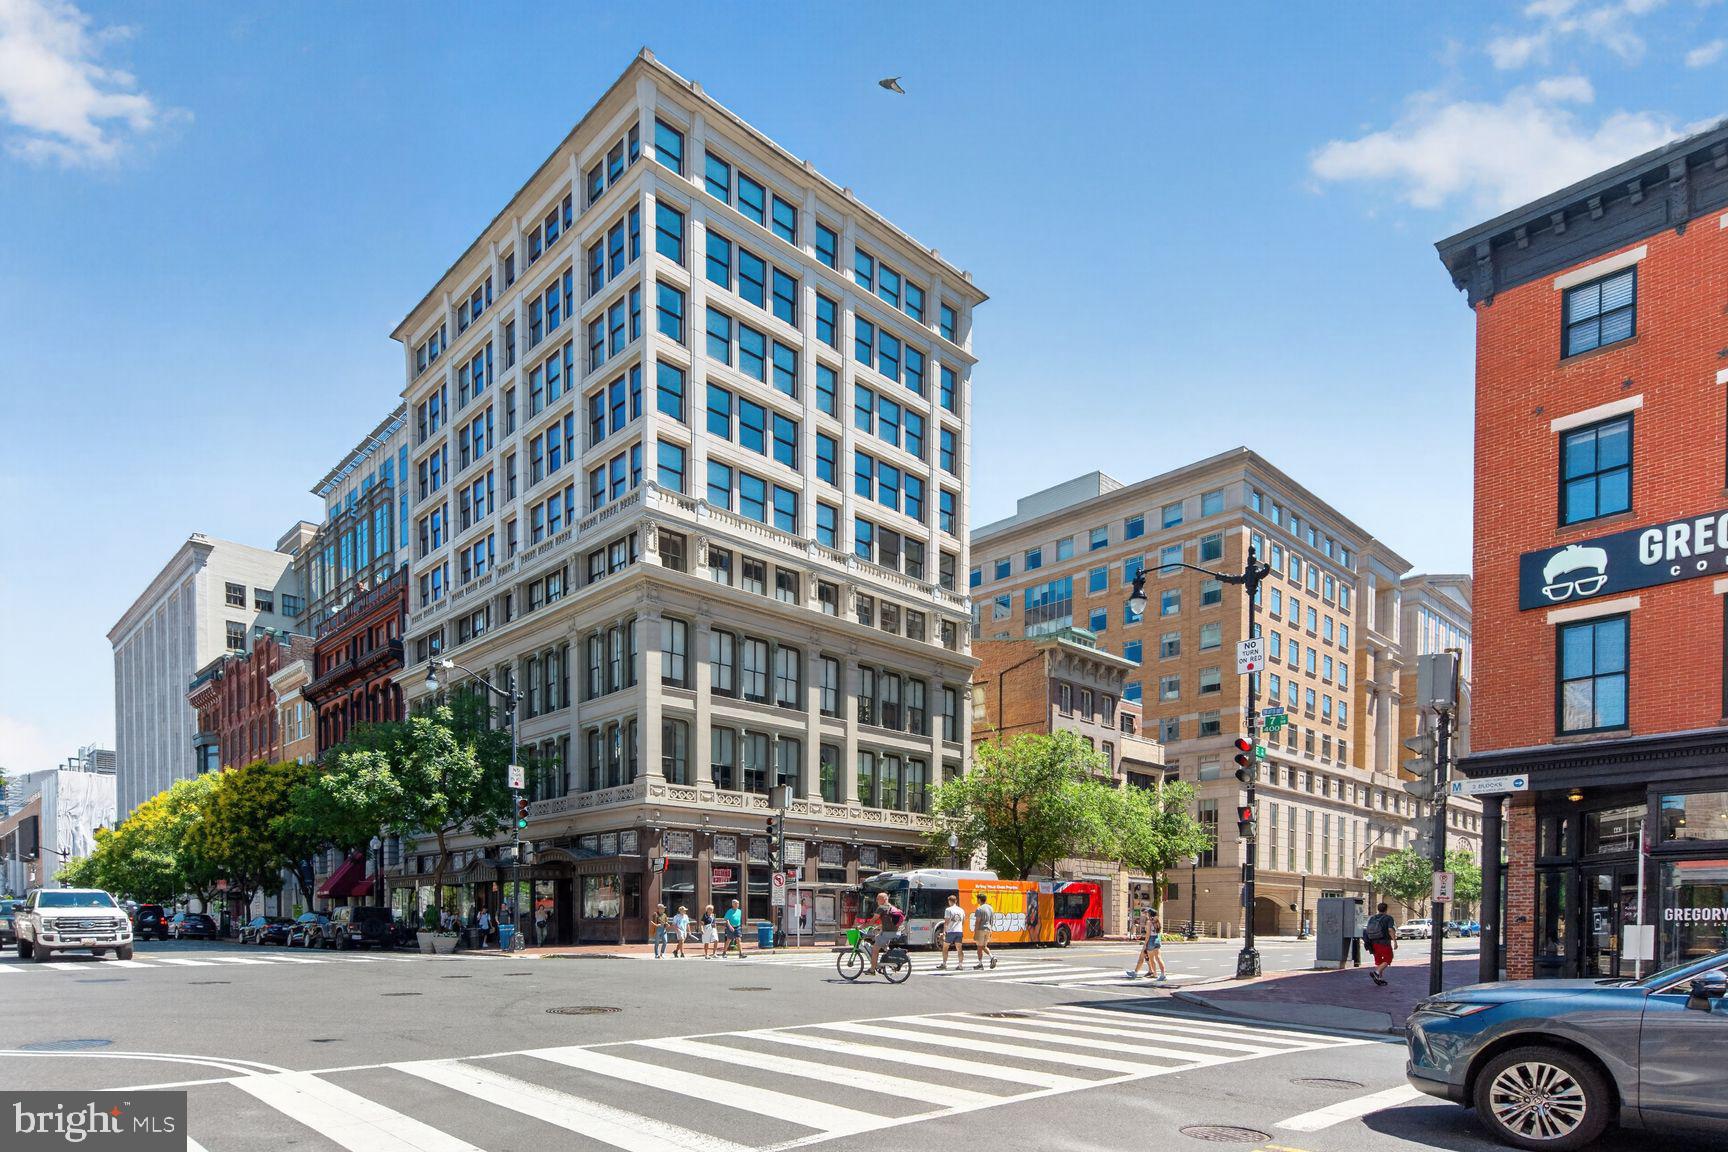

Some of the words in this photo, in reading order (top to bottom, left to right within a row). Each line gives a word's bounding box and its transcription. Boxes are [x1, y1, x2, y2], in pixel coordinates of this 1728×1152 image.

[1670, 555, 1728, 576] CO
[1244, 641, 1256, 649] NO
[1250, 654, 1262, 662] RED
[1270, 716, 1276, 725] 7
